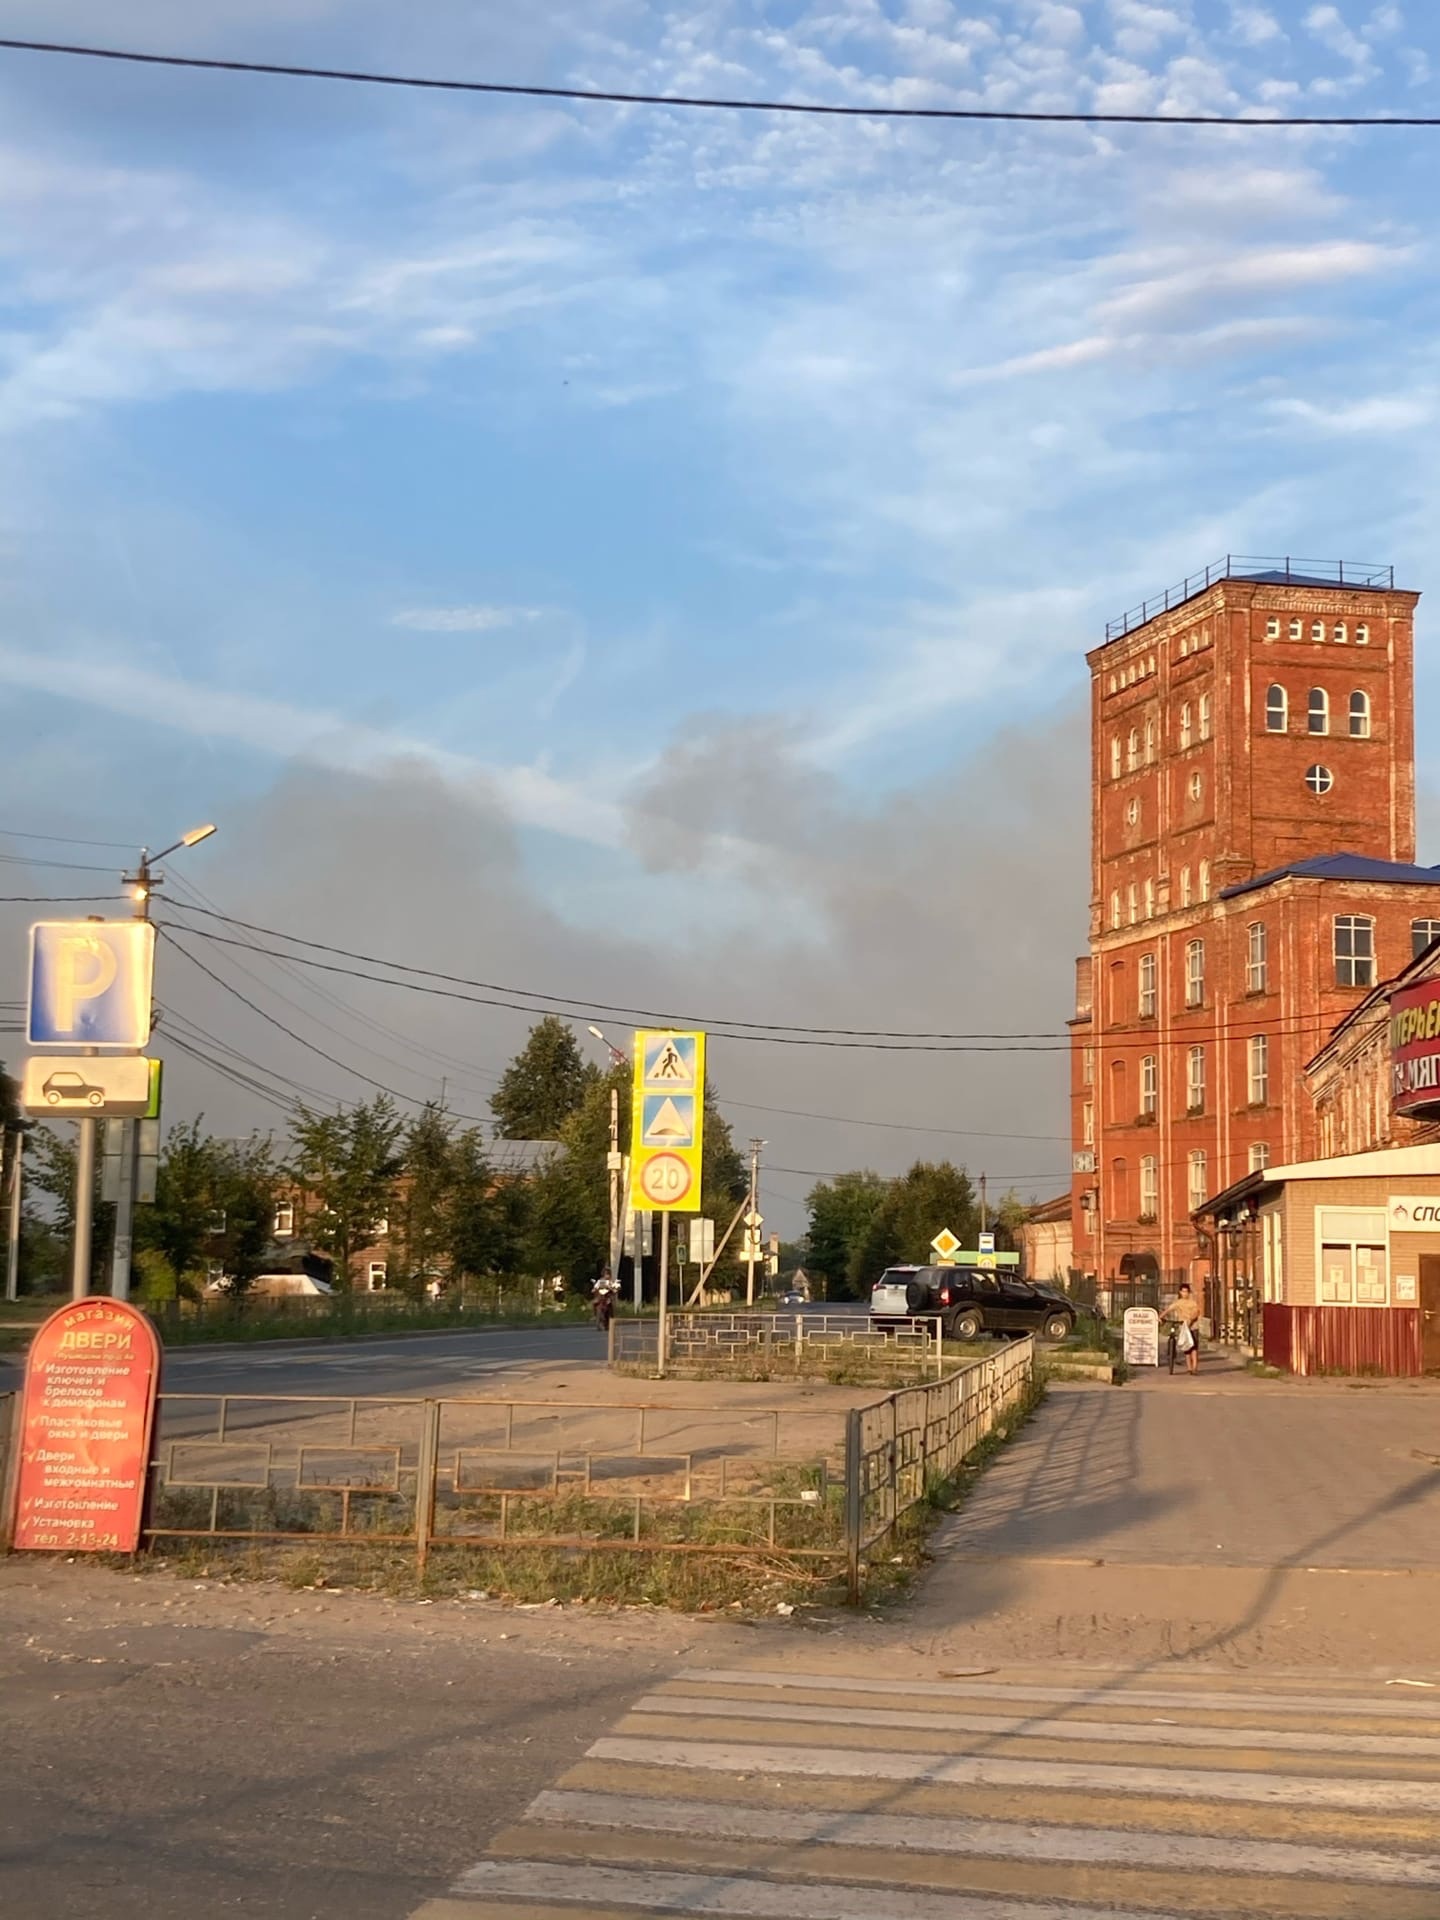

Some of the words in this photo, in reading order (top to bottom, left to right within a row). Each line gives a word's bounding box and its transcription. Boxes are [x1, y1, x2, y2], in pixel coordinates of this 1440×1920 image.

[651, 1169, 679, 1190] 20
[64, 1308, 136, 1331] магазин
[60, 1331, 131, 1349] ДВЕРИ
[45, 1363, 130, 1375] Изготовление
[48, 1376, 93, 1385] ключей
[45, 1386, 103, 1397] брелоков
[51, 1398, 126, 1410] домофонам
[40, 1416, 122, 1428] Пластиковые
[48, 1430, 76, 1439] окна
[80, 1431, 87, 1439] и
[91, 1431, 128, 1441] двери
[36, 1449, 75, 1462] Двери
[45, 1466, 99, 1475] входные
[102, 1467, 110, 1475] и
[44, 1478, 135, 1489] межкомнатные
[34, 1498, 118, 1511] Изготовление
[32, 1516, 94, 1528] Установка
